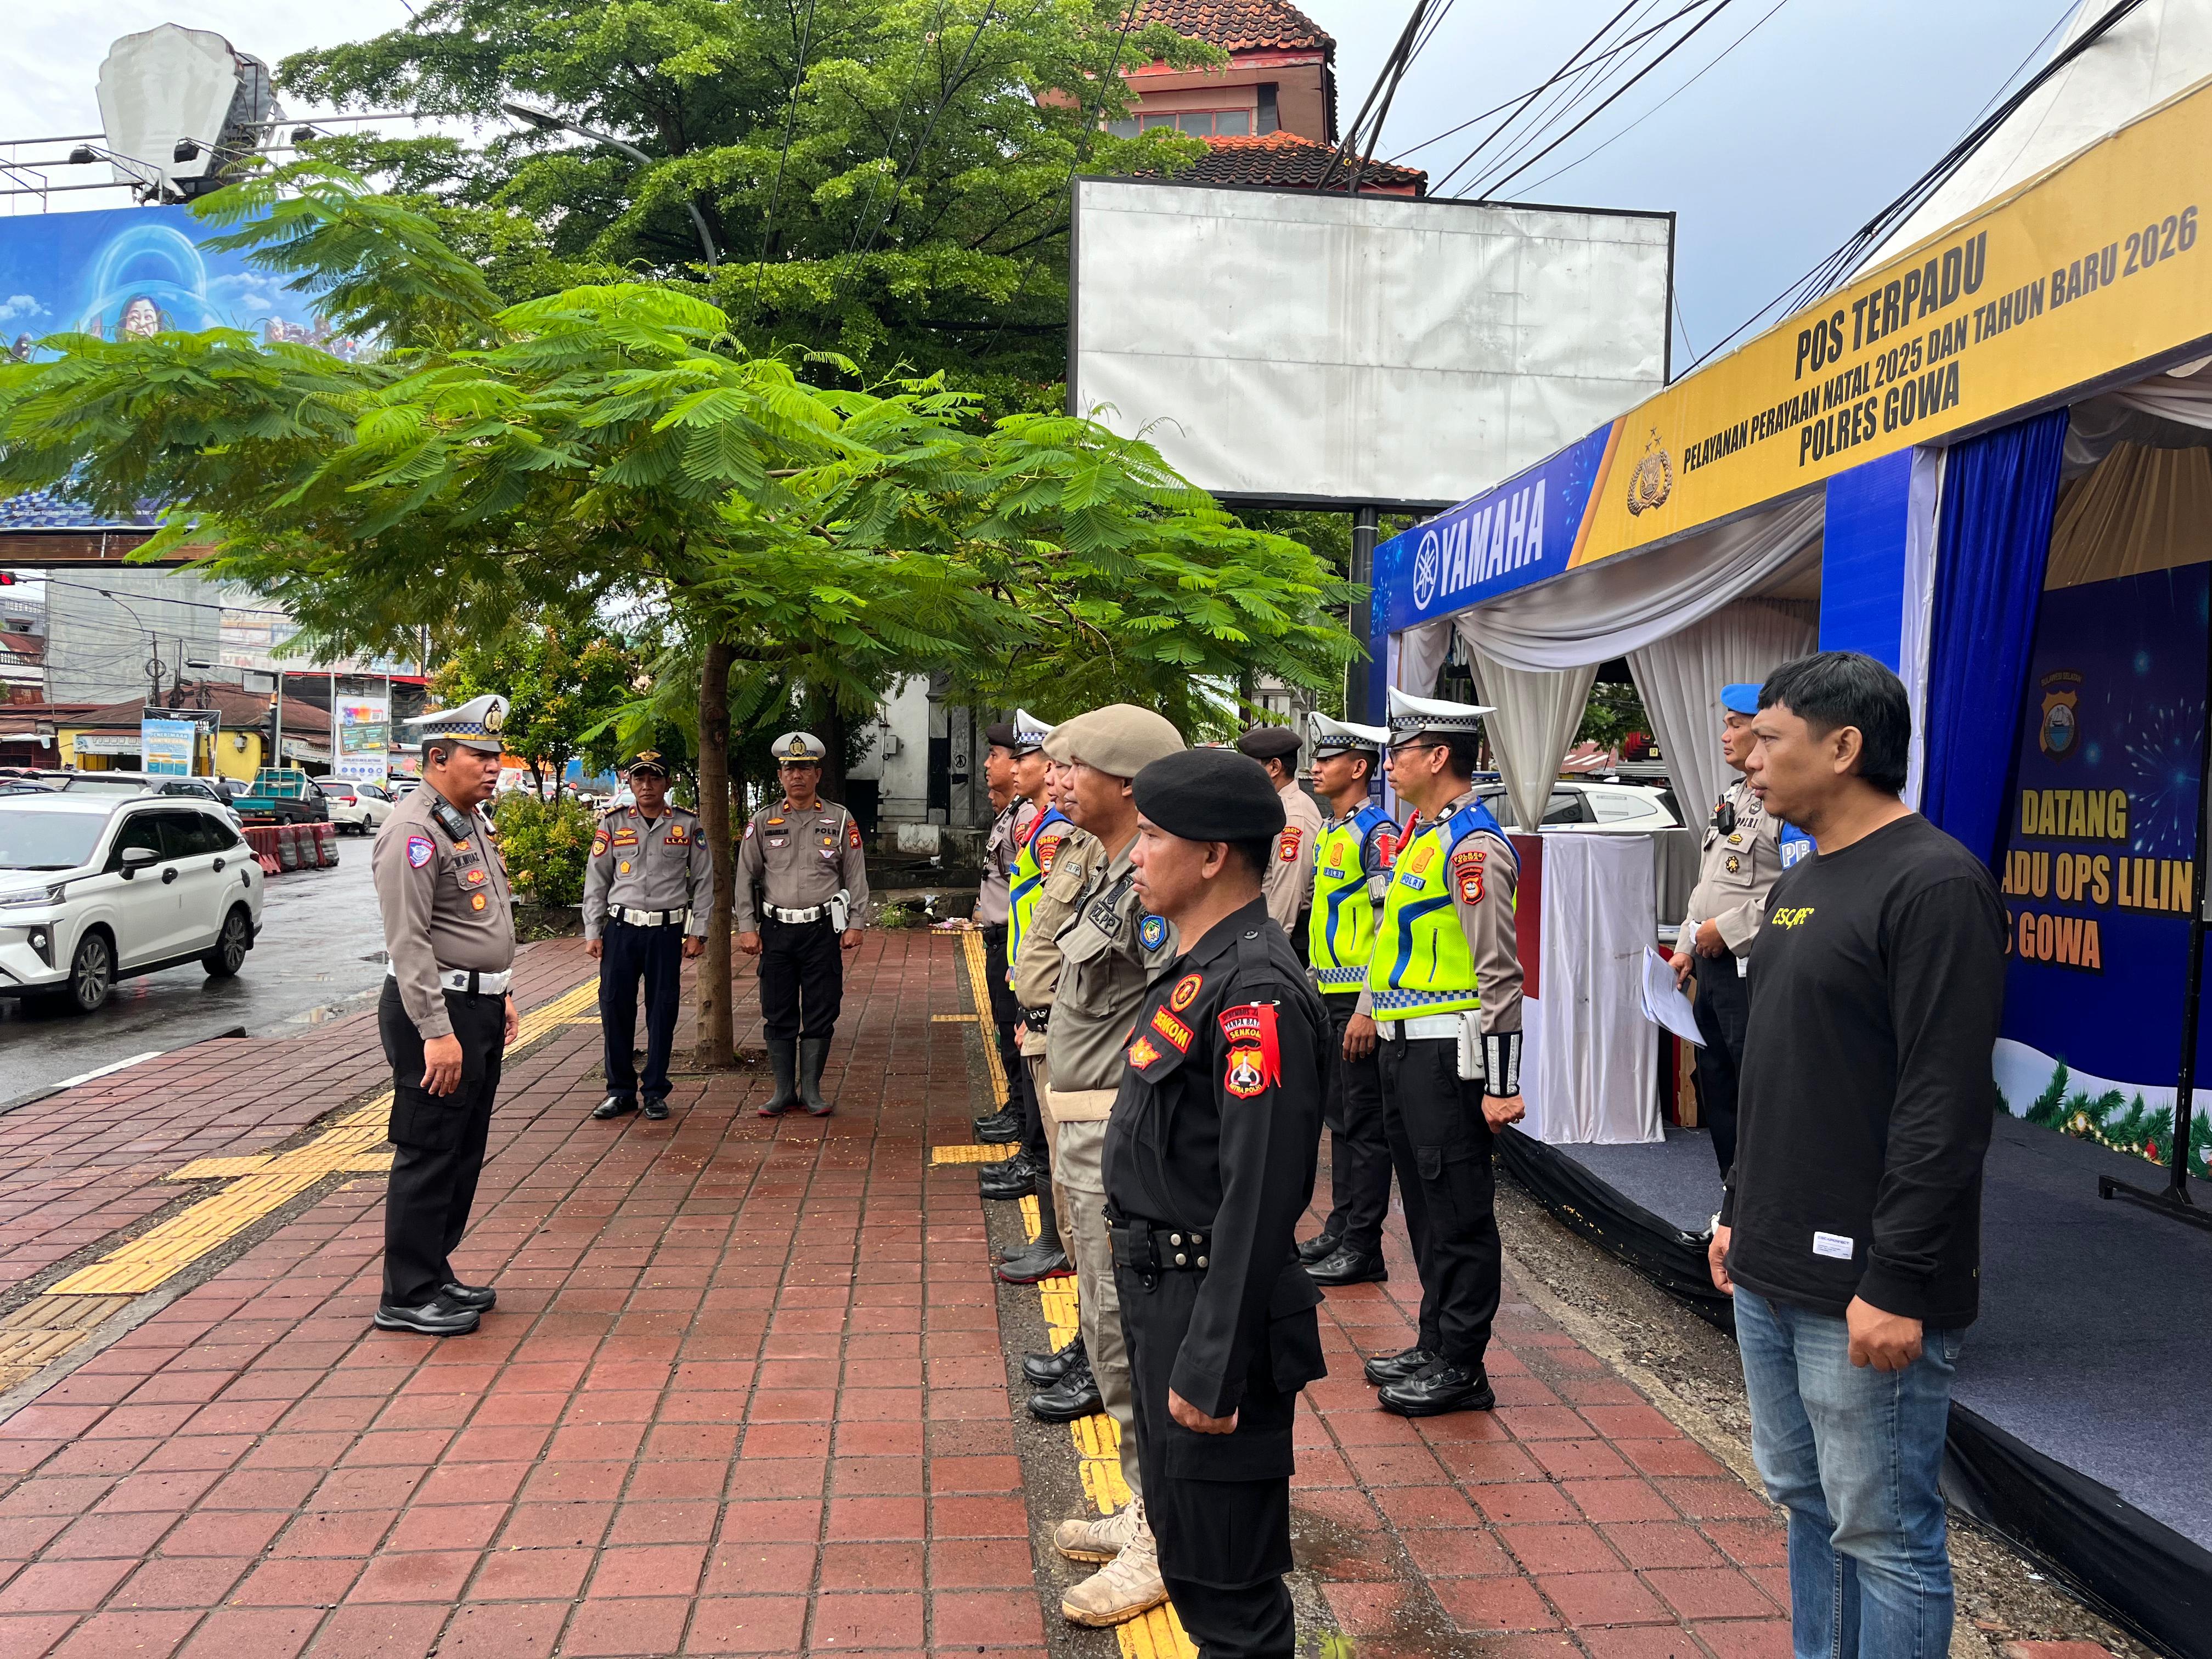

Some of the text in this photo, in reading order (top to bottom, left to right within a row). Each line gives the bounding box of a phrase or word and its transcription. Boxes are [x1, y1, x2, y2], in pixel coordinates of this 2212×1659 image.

[1795, 230, 1987, 381] POS TERPADU
[1683, 205, 2198, 475] PELAYANAN PERAYAAN NATAL 2025 DAN TAHUN BARU 2026
[1799, 360, 1959, 467] POLRES GOWA
[1440, 478, 1546, 597] YAMAHA
[815, 827, 839, 836] POLRI
[1736, 817, 1759, 828] POLRI
[2022, 789, 2127, 839] DATANG
[1324, 868, 1343, 878] POLRI
[1454, 853, 1483, 861] POLRES
[1401, 874, 1422, 888] POLRI
[2056, 853, 2109, 904] OPS
[2118, 857, 2193, 913] LILIN
[2019, 911, 2100, 969] GOWA
[1154, 1011, 1189, 1047] SENKOM
[1225, 1018, 1260, 1031] TANPA BAT
